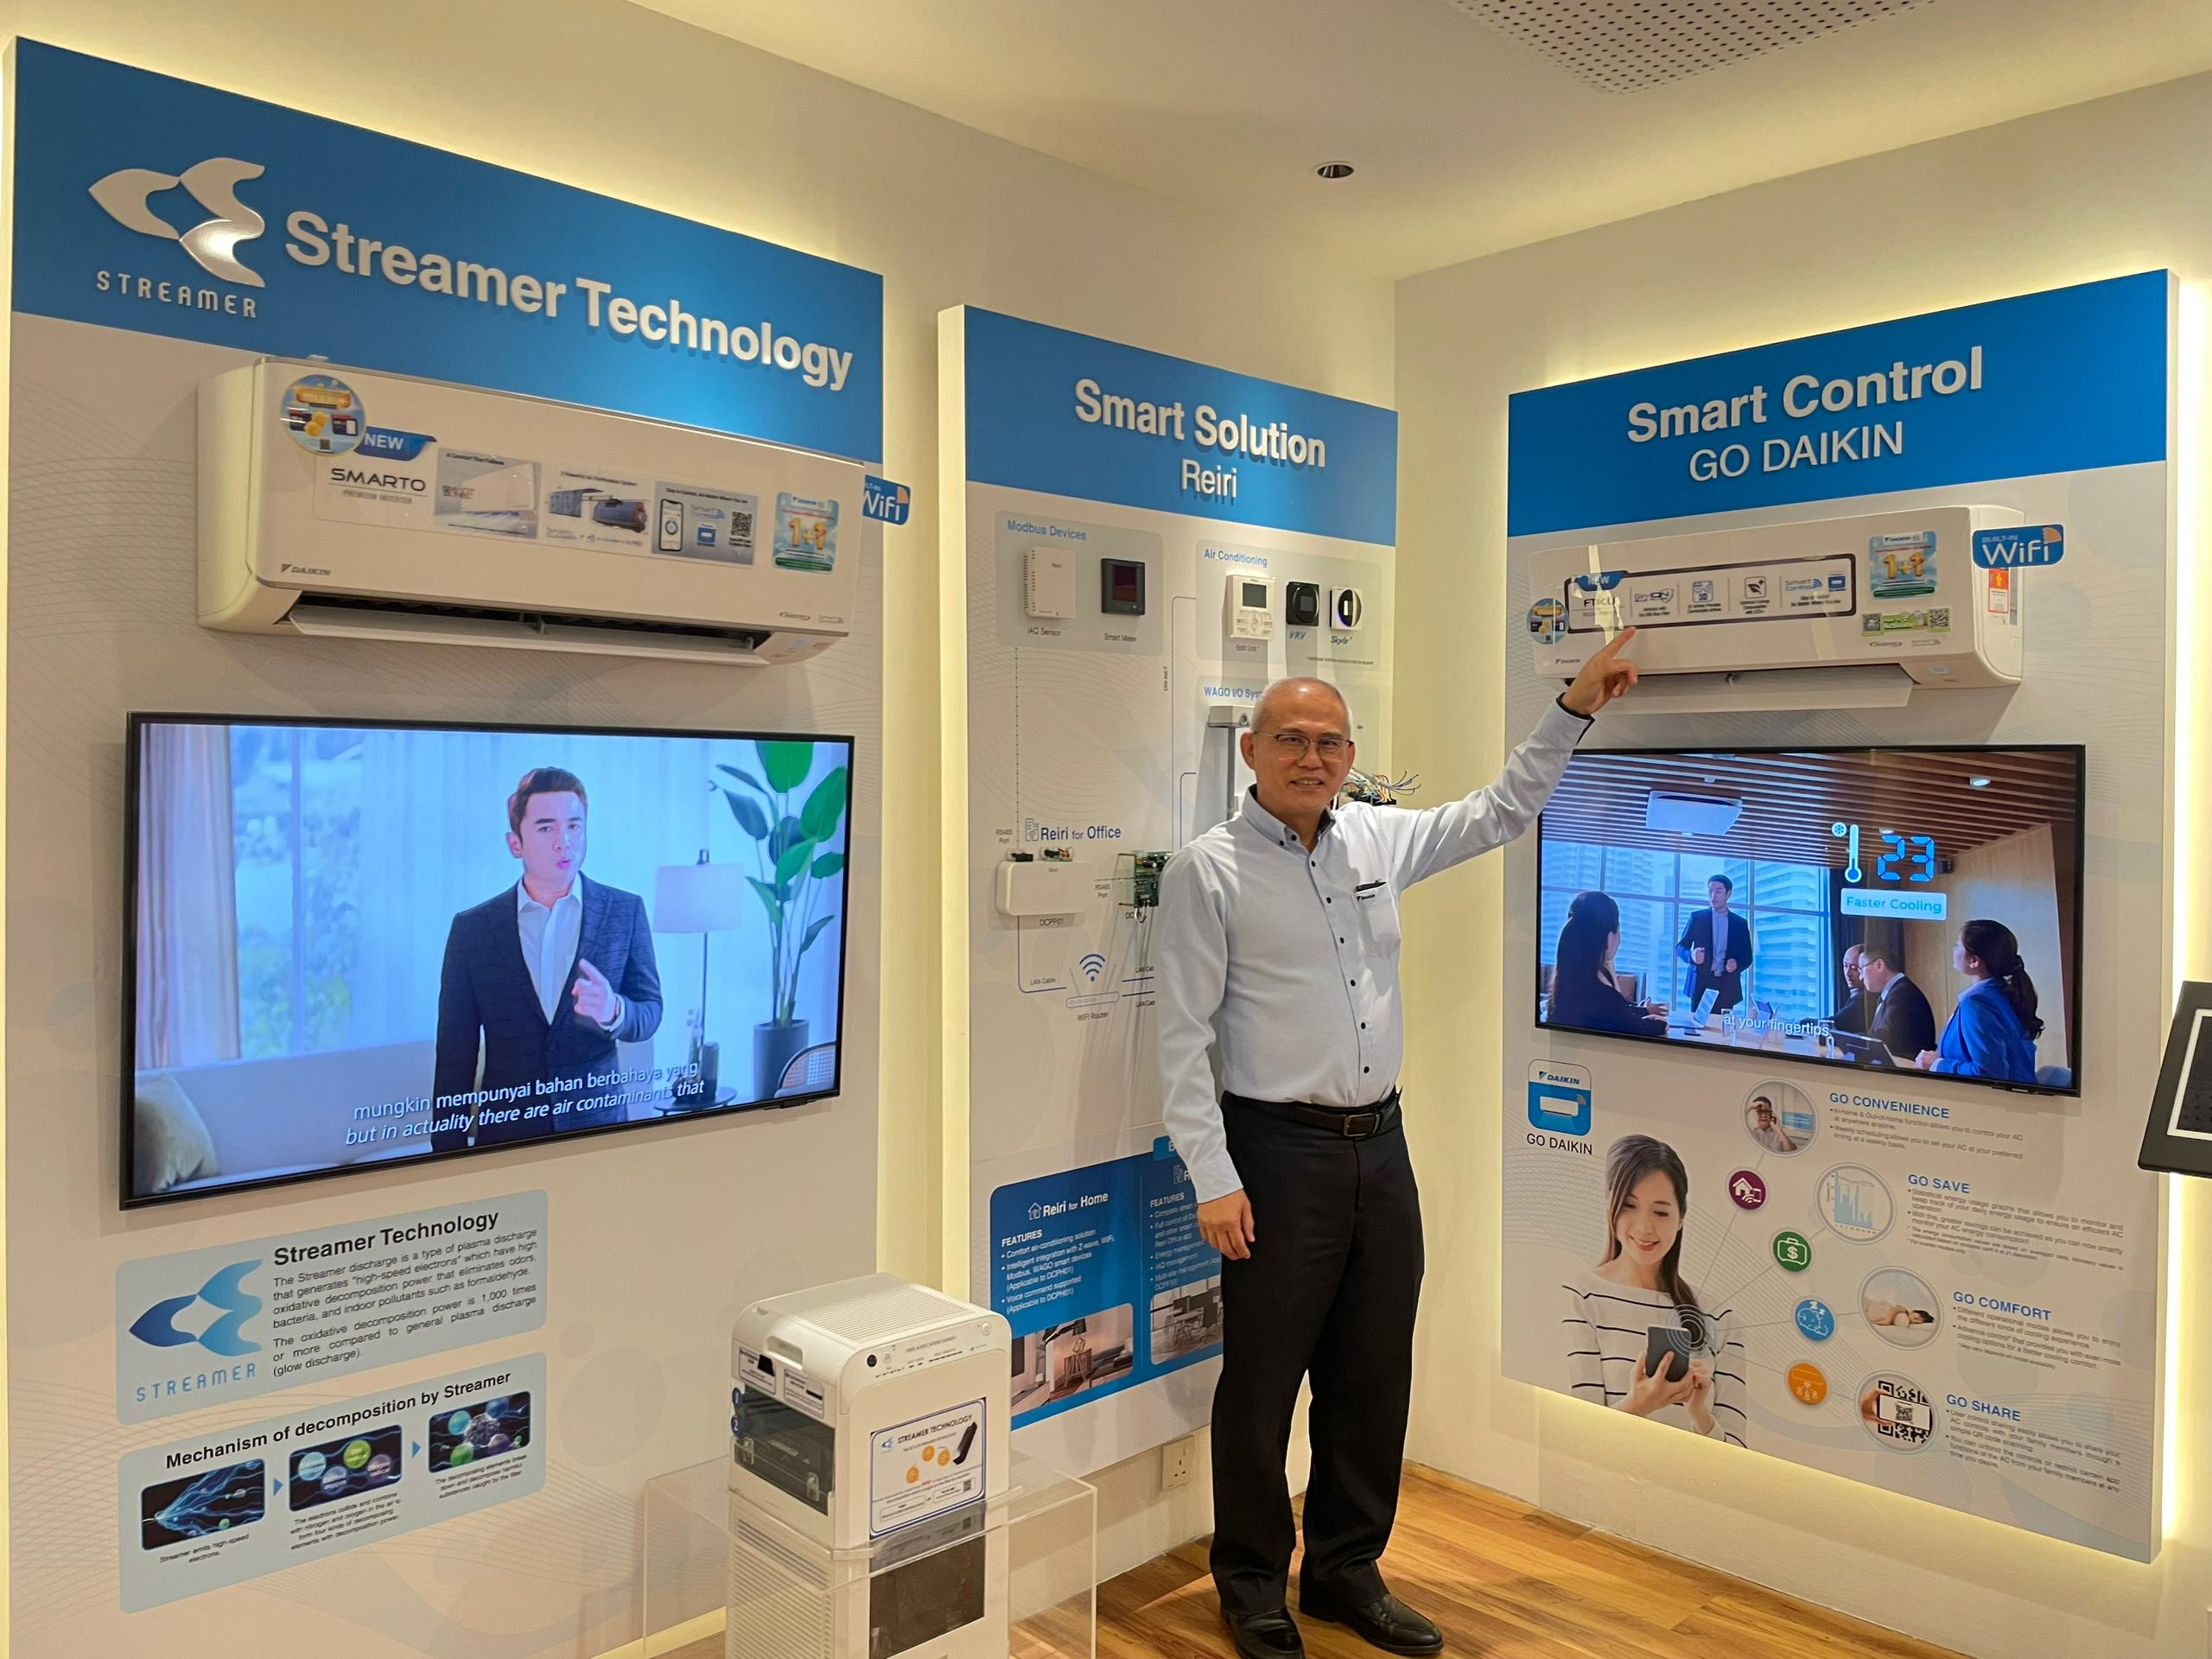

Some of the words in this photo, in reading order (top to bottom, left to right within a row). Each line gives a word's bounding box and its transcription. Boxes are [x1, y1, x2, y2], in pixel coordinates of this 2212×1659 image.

[97, 270, 257, 319] STREAMER
[285, 210, 567, 319] Streamer
[575, 276, 854, 392] Technology
[1628, 386, 1767, 442] Smart
[1783, 346, 1983, 419] Control
[1075, 378, 1185, 440] Smart
[1195, 406, 1326, 468] Solution
[364, 433, 404, 450] NEW
[1688, 444, 1751, 482] GO
[1763, 422, 1903, 474] DAIKIN
[331, 467, 426, 492] SMARTO
[1181, 458, 1238, 499] Reiri
[1007, 519, 1046, 535] Modbus
[1050, 525, 1087, 540] Devices
[1205, 549, 1216, 559] Air
[1218, 550, 1268, 568] Conditioning
[1982, 540, 2049, 565] WiFi
[1204, 687, 1230, 696] WAGO
[1245, 689, 1261, 700] Sys
[1040, 827, 1069, 841] Reiri
[1072, 830, 1084, 839] for
[1087, 825, 1122, 839] Office
[1877, 835, 1935, 882] 23
[1847, 896, 1886, 909] Faster
[1891, 899, 1942, 914] Cooling
[1724, 1014, 1736, 1027] at
[1739, 1016, 1768, 1032] your
[353, 1097, 429, 1121] mungkin
[436, 1082, 531, 1109] mempunyai
[536, 1077, 582, 1096] bahan
[587, 1068, 662, 1089] berbahaya
[667, 1061, 698, 1080] yang
[1548, 1074, 1580, 1085] DAIKIN
[346, 1128, 375, 1146] but
[382, 1124, 397, 1140] in
[403, 1115, 474, 1137] actuality
[480, 1107, 519, 1126] there
[524, 1103, 549, 1119] are
[553, 1101, 571, 1115] air
[576, 1087, 673, 1112] contaminants
[677, 1080, 705, 1096] that
[1829, 1092, 1848, 1104] GO
[1853, 1096, 1949, 1119] CONVENIENCE
[1527, 1133, 1545, 1147] GO
[1549, 1137, 1592, 1156] DAIKIN
[1908, 1174, 1929, 1186] GO
[1933, 1178, 1970, 1194] SAVE
[1043, 1201, 1066, 1217] Reiri
[1080, 1192, 1109, 1207] Home
[1150, 1192, 1185, 1208] FEATURES
[274, 1235, 375, 1265] Streamer
[380, 1212, 499, 1245] Technology
[1001, 1230, 1043, 1248] FEATURES
[273, 1277, 294, 1287] The
[298, 1266, 346, 1283] Streamer
[349, 1255, 397, 1273] discharge
[401, 1253, 409, 1262] is
[423, 1248, 442, 1259] type
[446, 1243, 454, 1253] of
[457, 1238, 491, 1252] plasma
[494, 1229, 537, 1244] discharge
[273, 1289, 293, 1301] that
[297, 1278, 348, 1299] generates
[465, 1249, 491, 1262] which
[493, 1245, 515, 1258] have
[518, 1241, 537, 1254] high
[273, 1298, 320, 1315] oxidative
[325, 1281, 397, 1305] decomposition
[403, 1275, 433, 1289] power
[436, 1270, 454, 1281] that
[459, 1261, 505, 1276] eliminates
[321, 1306, 341, 1319] and
[345, 1300, 376, 1313] indoor
[378, 1288, 425, 1307] pollutants
[429, 1284, 450, 1296] such
[454, 1281, 464, 1290] as
[273, 1338, 294, 1348] The
[301, 1325, 347, 1343] oxidative
[354, 1307, 427, 1331] decomposition
[433, 1300, 462, 1314] power
[467, 1296, 475, 1306] is
[512, 1283, 537, 1295] times
[1954, 1291, 1974, 1304] GO
[1979, 1296, 2051, 1321] COMFORT
[273, 1352, 284, 1363] or
[293, 1344, 320, 1357] more
[329, 1331, 381, 1350] compared
[389, 1326, 398, 1337] to
[406, 1315, 443, 1334] general
[450, 1307, 485, 1324] plasma
[493, 1296, 537, 1313] discharge
[137, 1363, 257, 1402] STREAMER
[273, 1362, 302, 1377] (glow
[166, 1433, 268, 1470] Mechanism
[273, 1426, 290, 1443] of
[296, 1396, 416, 1437] decomposition
[421, 1389, 439, 1407] by
[444, 1370, 512, 1398] Streamer
[1947, 1394, 1967, 1408] GO
[1972, 1400, 2021, 1421] SHARE
[898, 1427, 929, 1445] STREAMER
[931, 1414, 972, 1433] TECHNOLOGY
